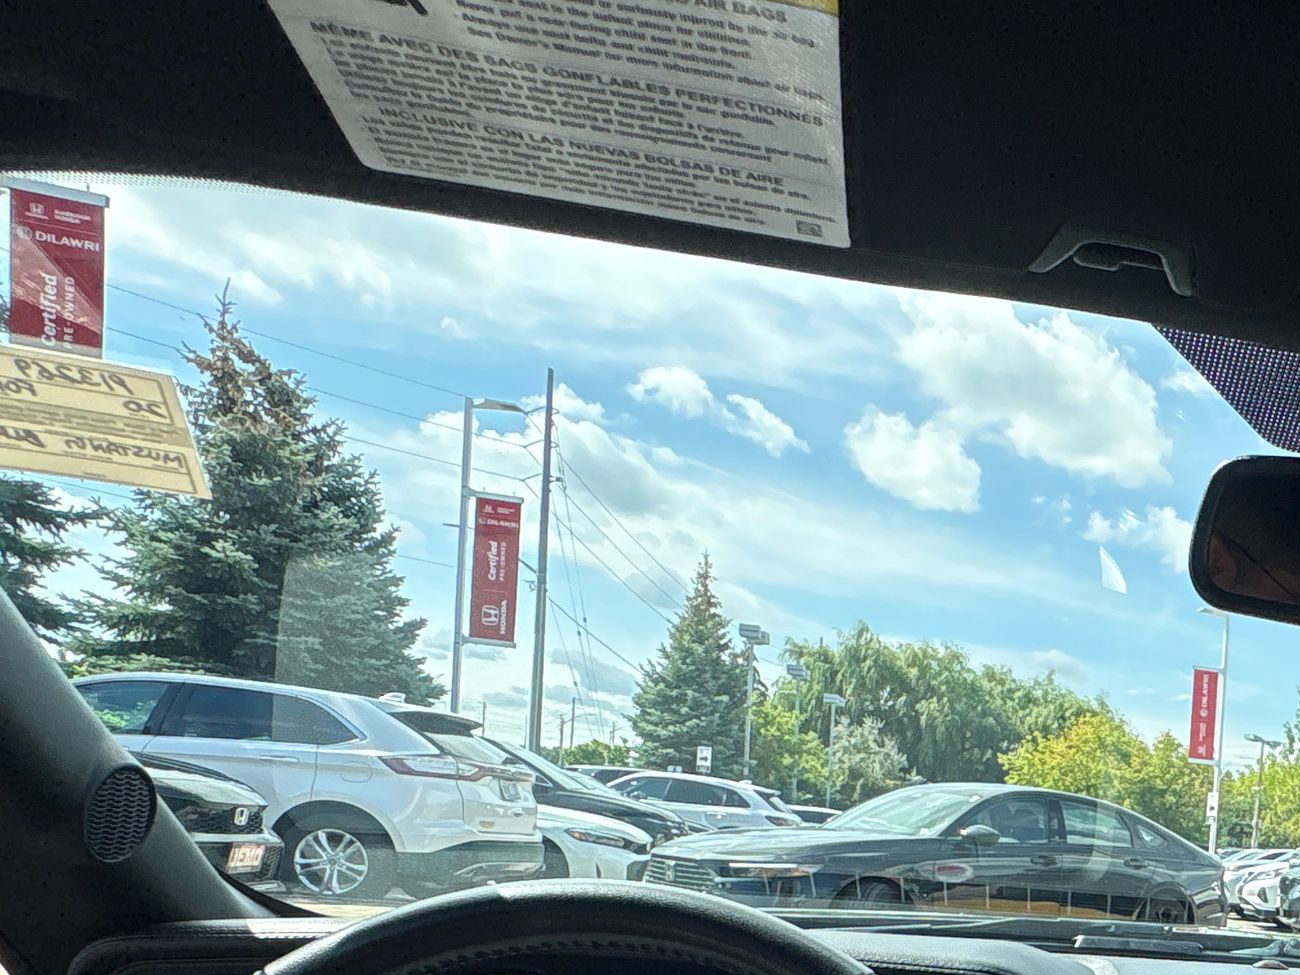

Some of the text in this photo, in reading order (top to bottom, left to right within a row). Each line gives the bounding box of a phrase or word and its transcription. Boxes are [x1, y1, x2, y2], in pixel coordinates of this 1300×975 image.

[379, 34, 433, 54] AVEC
[436, 45, 481, 64] DES
[482, 55, 538, 74] SACS
[541, 64, 672, 96] GONFLABLES
[378, 107, 784, 187] INCLUSIVE CON LAS NUEVAS BOLSAS DE AIRE
[35, 230, 100, 252] DILAWRI
[39, 267, 61, 347] Certified
[62, 276, 76, 350] PRE-OWNED
[486, 540, 500, 581] Certified
